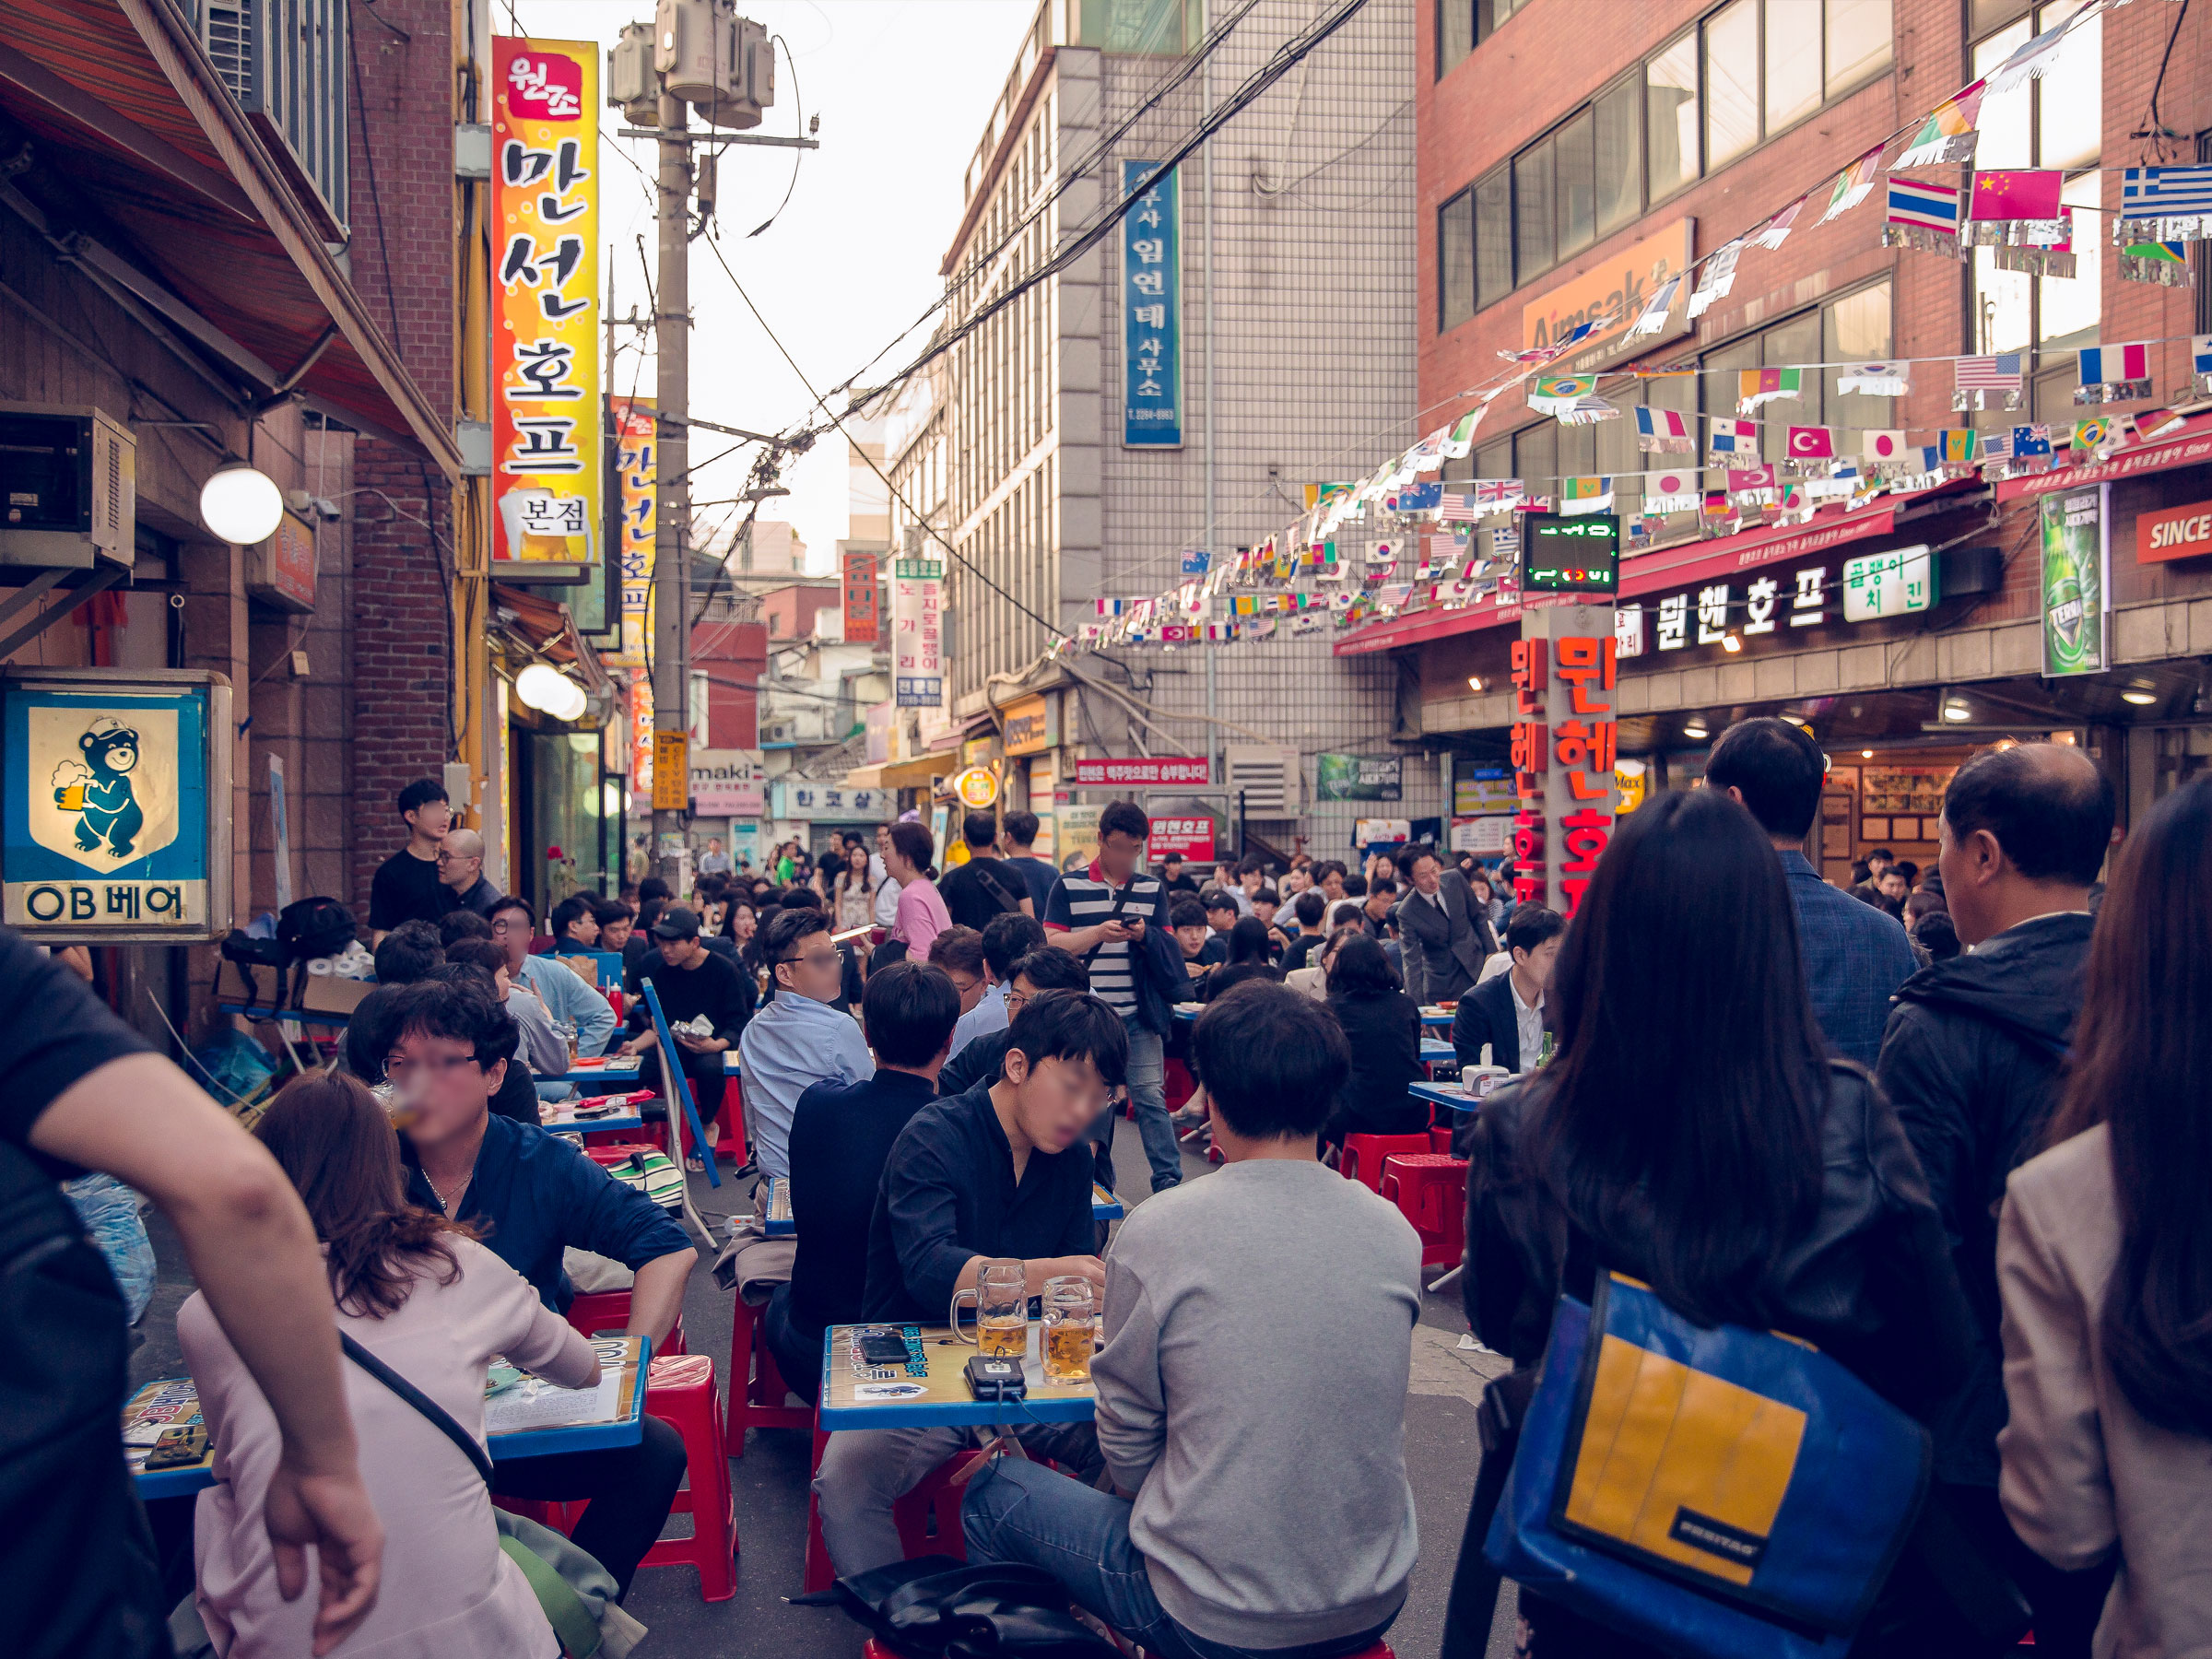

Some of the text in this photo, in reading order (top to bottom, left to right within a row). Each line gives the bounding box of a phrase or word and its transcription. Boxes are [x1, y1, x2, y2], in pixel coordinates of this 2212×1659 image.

[509, 57, 581, 116] 원조
[504, 140, 590, 472] 만선호프
[1132, 238, 1166, 331] 임연태
[521, 499, 584, 533] 본점
[2149, 513, 2212, 549] SINCE
[1849, 553, 1905, 589] 골뱅이
[1865, 581, 1924, 615] 치킨
[900, 582, 916, 670] 노가리
[1656, 566, 1828, 652] 뮌헨호프
